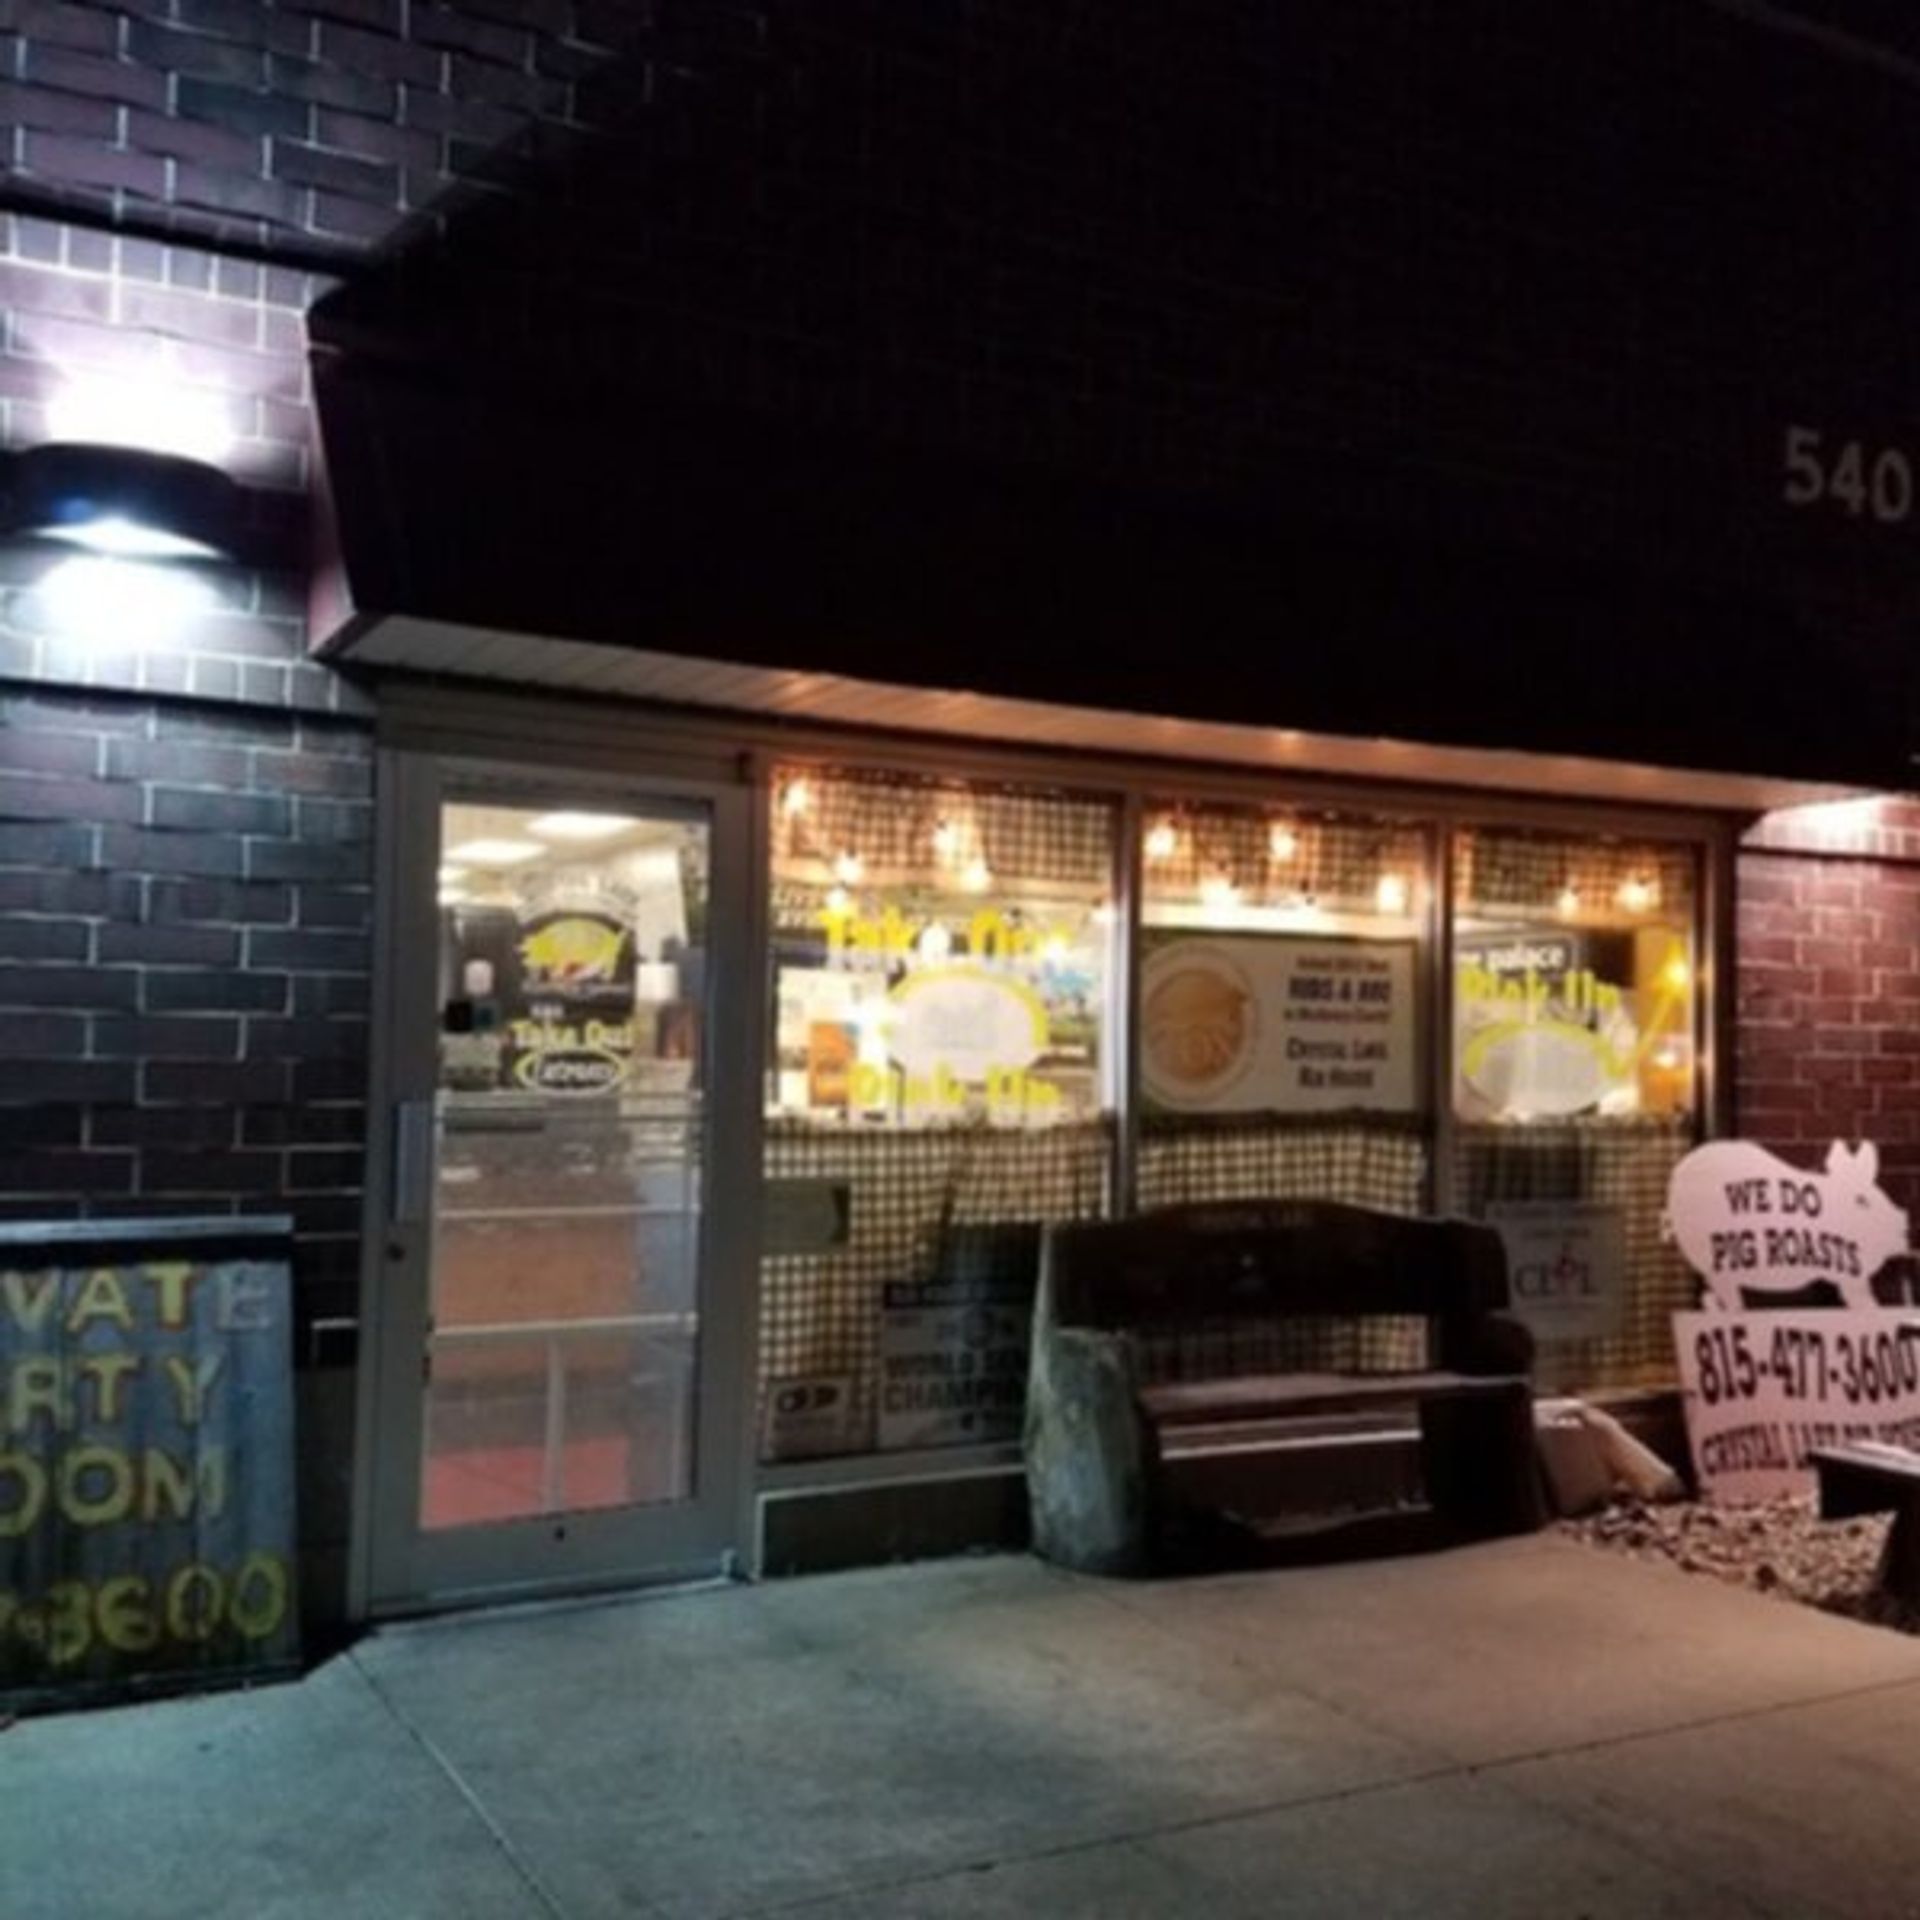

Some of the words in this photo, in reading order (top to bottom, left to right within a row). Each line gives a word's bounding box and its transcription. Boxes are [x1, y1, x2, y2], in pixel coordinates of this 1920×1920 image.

[1786, 425, 1911, 521] 540
[1725, 1180, 1770, 1216] WE
[1779, 1180, 1823, 1217] DO
[1711, 1230, 1756, 1273] PIG
[1766, 1228, 1862, 1278] ROASTS
[10, 1348, 228, 1432] RTY
[1696, 1322, 1920, 1406] 815-477-3600
[1701, 1420, 1790, 1476] CRYSTAL
